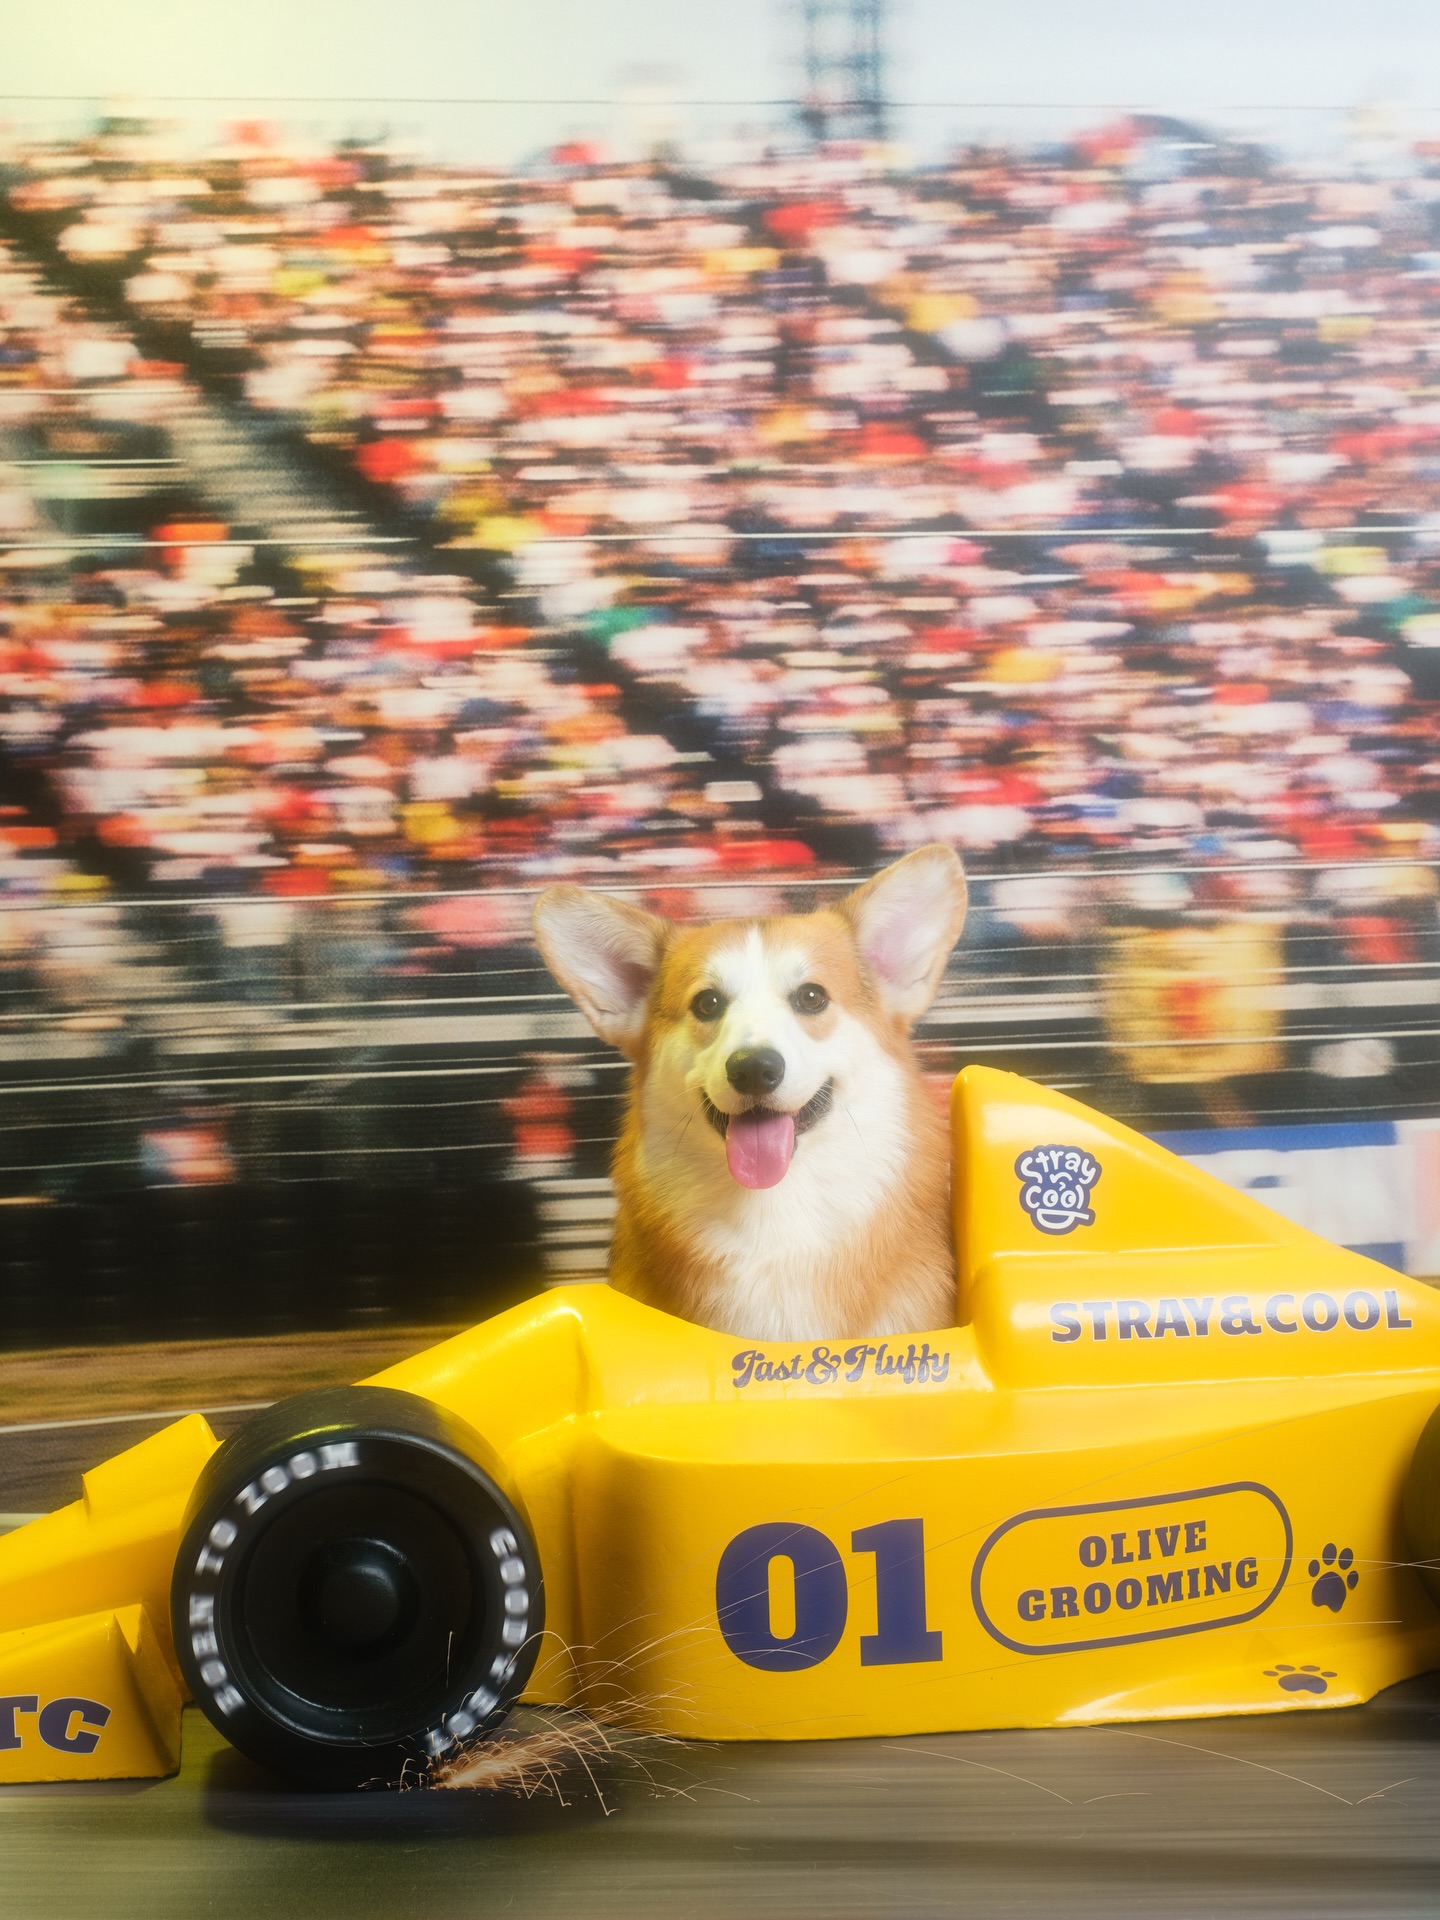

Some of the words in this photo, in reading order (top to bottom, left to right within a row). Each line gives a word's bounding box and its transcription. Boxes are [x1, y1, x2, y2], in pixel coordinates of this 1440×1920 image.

[1020, 1150, 1097, 1185] Stray
[1050, 1289, 1413, 1343] STRAY&COOL
[234, 1441, 361, 1517] ZOOM
[195, 1519, 238, 1576] TO
[1079, 1520, 1207, 1568] OLIVE
[489, 1527, 529, 1647] GOOD
[716, 1518, 943, 1672] 01
[1017, 1557, 1259, 1622] GROOMING
[189, 1593, 247, 1718] BORN
[424, 1685, 498, 1757] BOY
